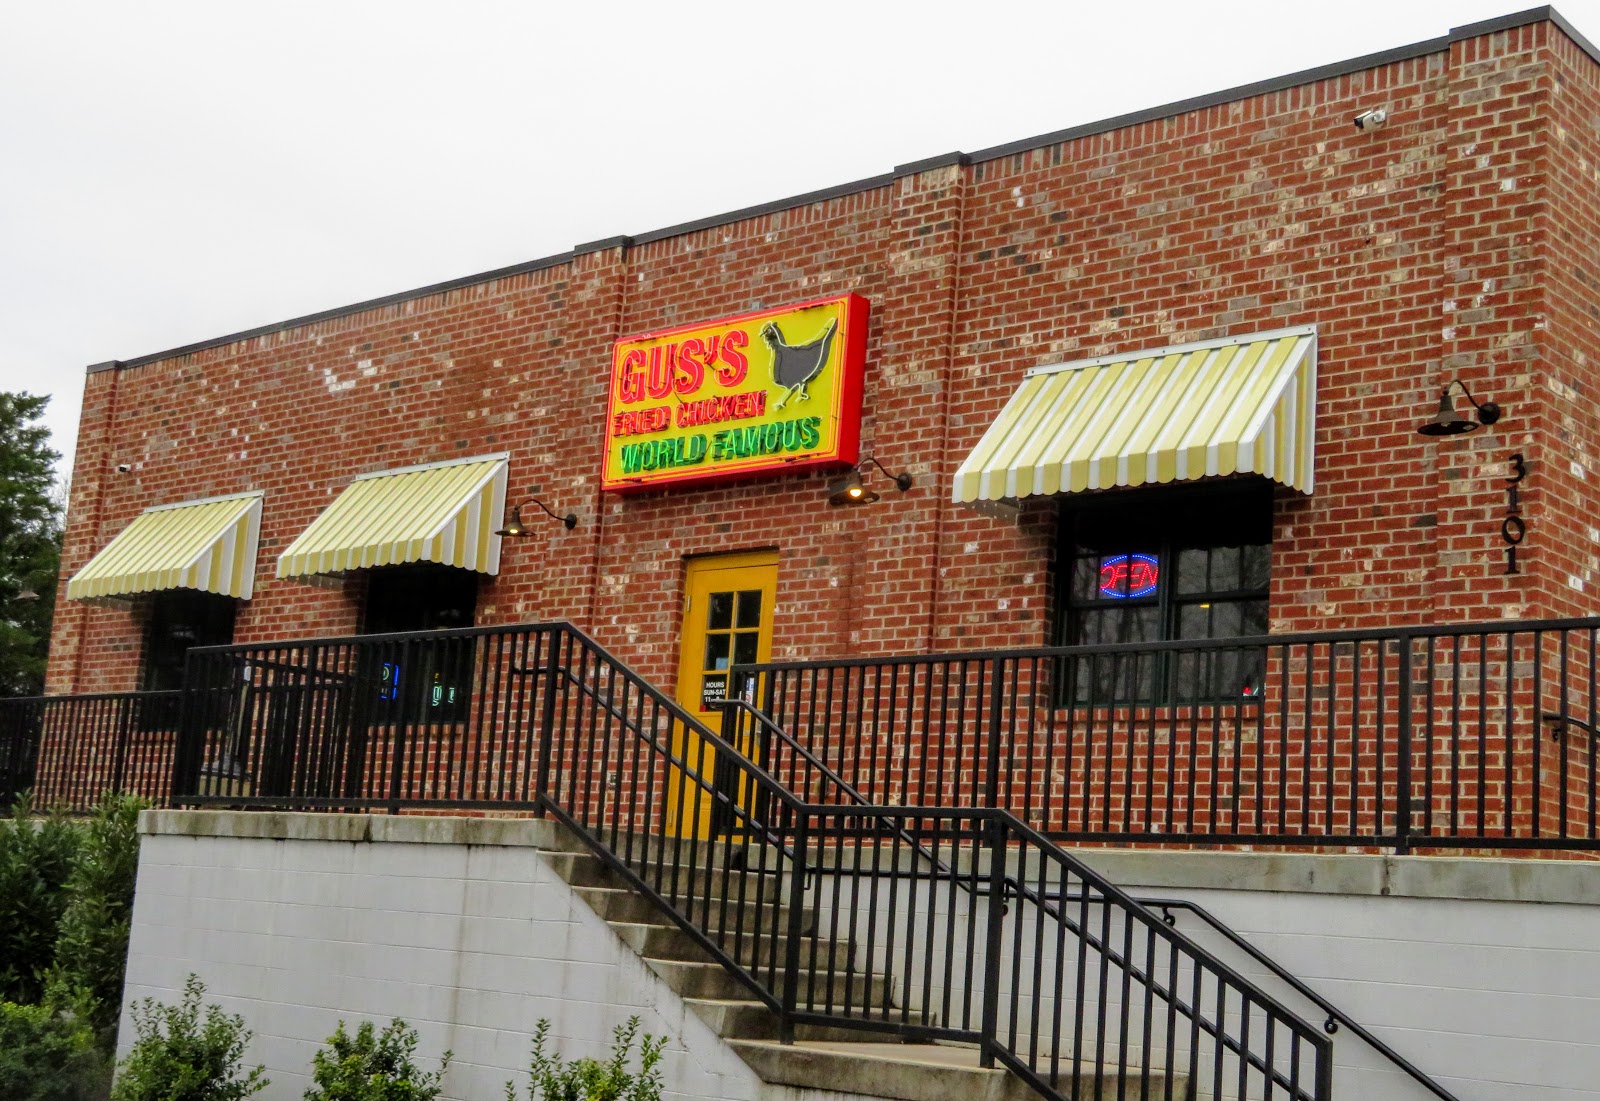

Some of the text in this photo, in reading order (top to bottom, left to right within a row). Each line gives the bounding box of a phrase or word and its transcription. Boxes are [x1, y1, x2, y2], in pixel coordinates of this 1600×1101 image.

[614, 329, 749, 404] GUS'S
[613, 390, 767, 438] FRIED CHICKEN
[620, 416, 822, 474] WORLD FAMOUS
[1501, 453, 1526, 575] 3101
[1100, 561, 1159, 590] OPEN
